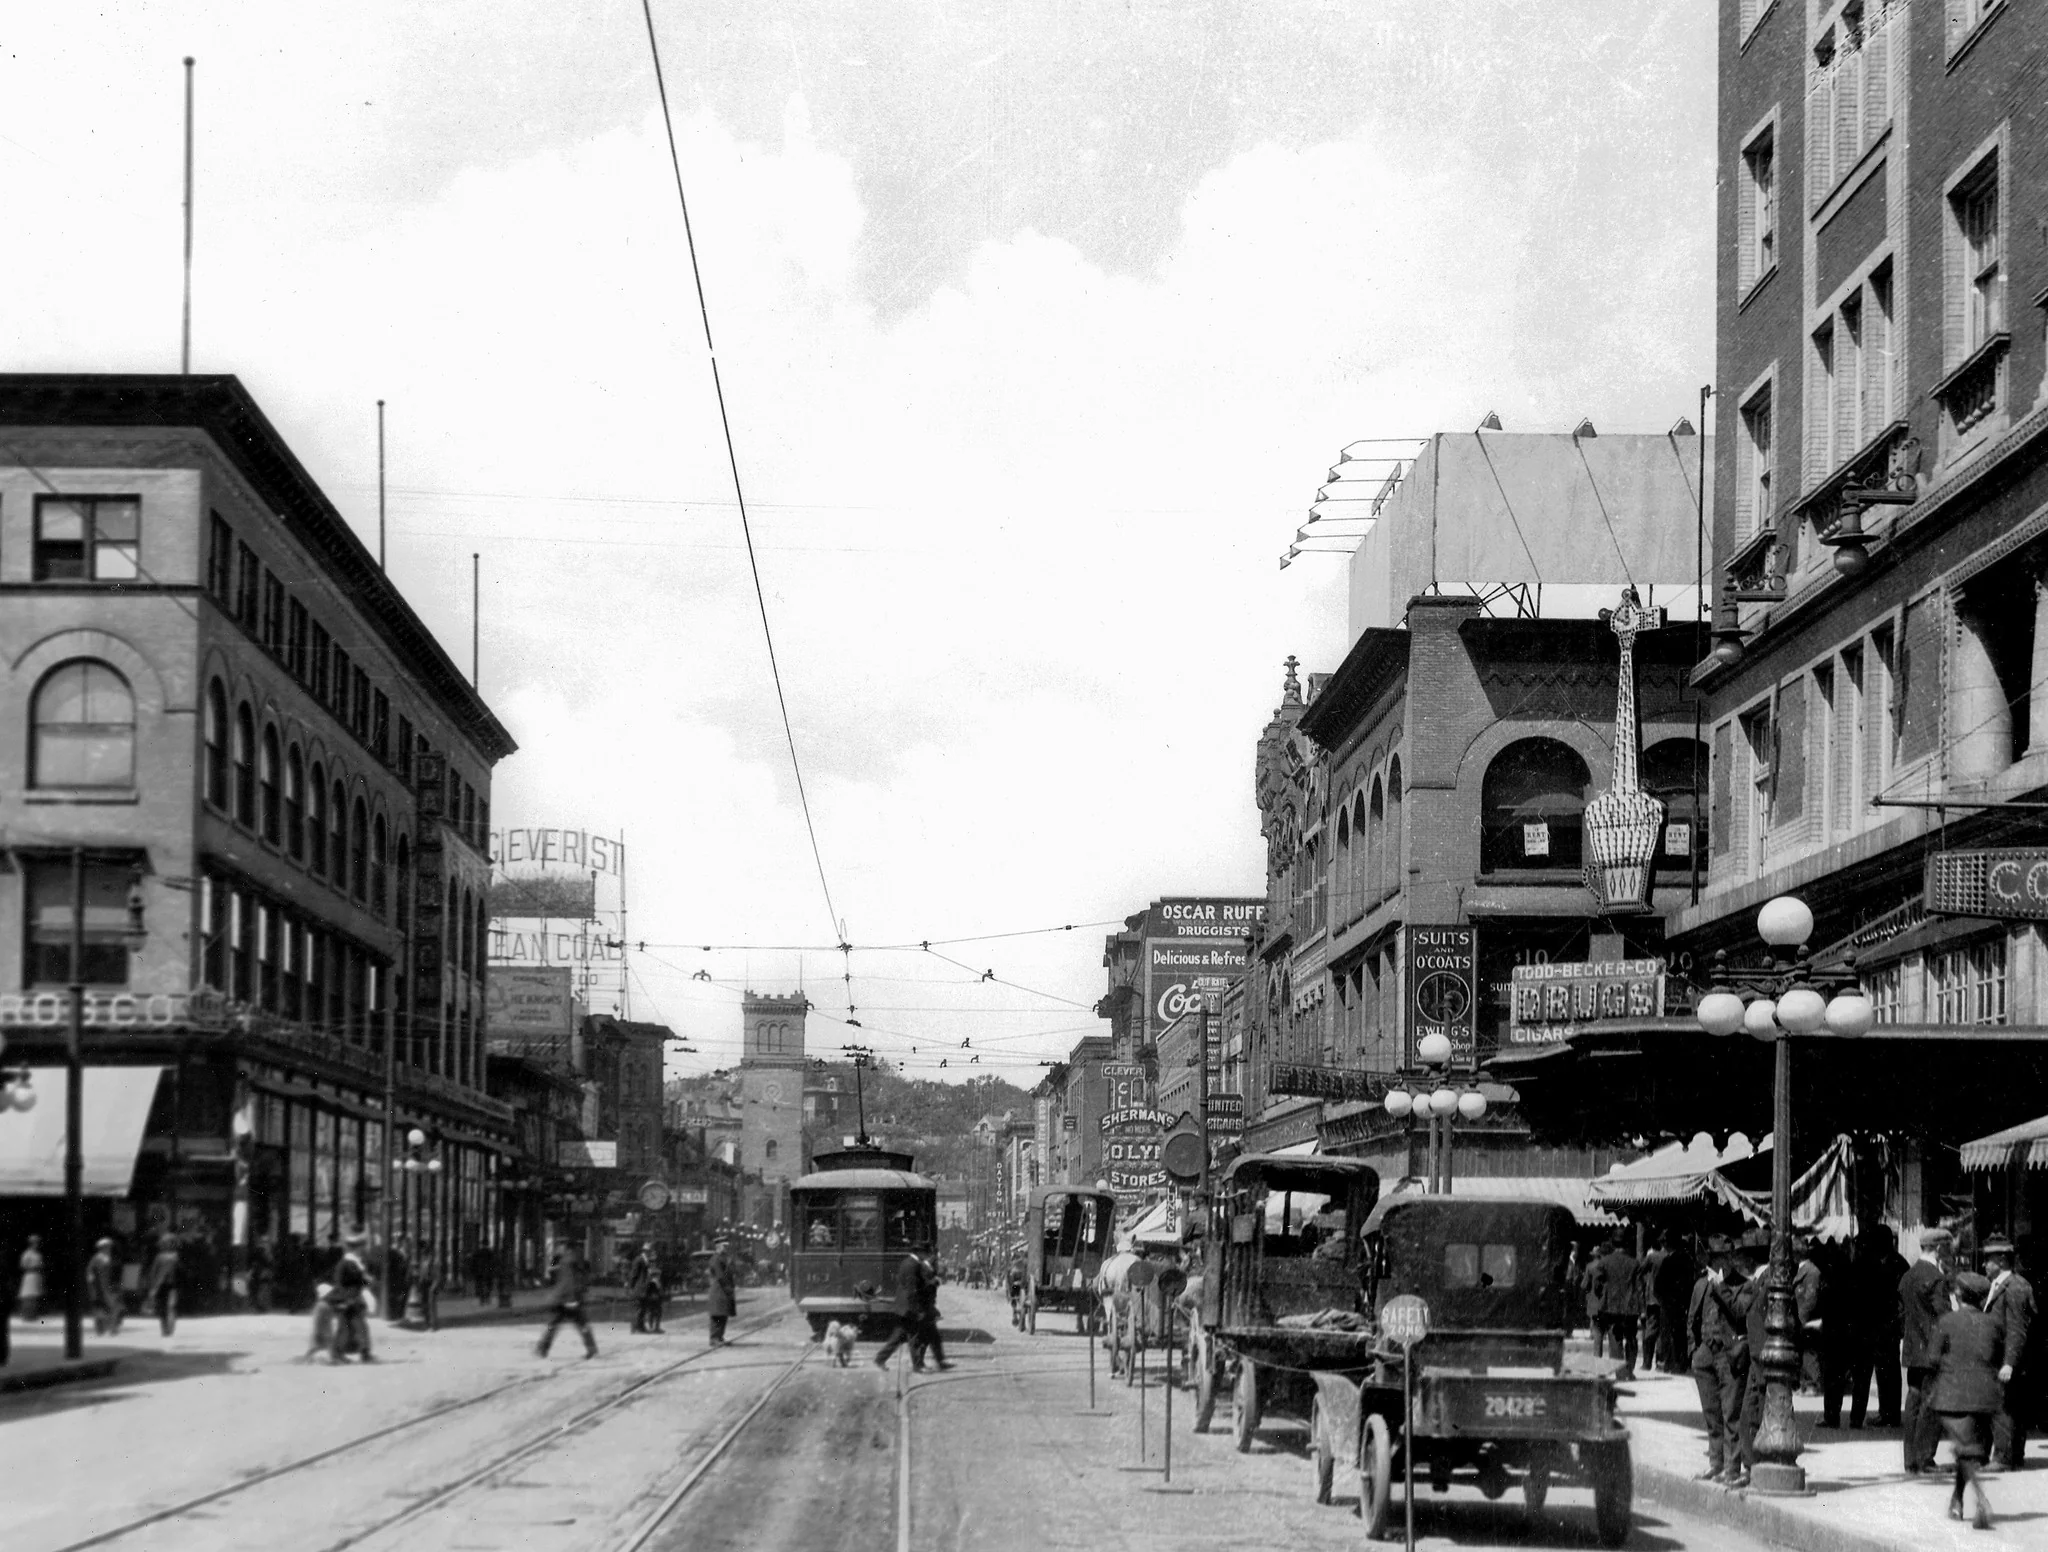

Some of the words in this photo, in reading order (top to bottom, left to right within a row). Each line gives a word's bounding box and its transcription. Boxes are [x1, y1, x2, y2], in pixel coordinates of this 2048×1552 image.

[509, 828, 624, 877] EVERIST
[1163, 905, 1215, 920] OSCAR
[1224, 905, 1265, 920] RUFF
[1178, 926, 1250, 936] DRUGGISTS
[1418, 932, 1470, 945] SUITS
[557, 933, 623, 961] COAL
[1153, 950, 1200, 965] Delicious
[1202, 953, 1209, 965] &
[1416, 955, 1471, 969] O'COATS
[1518, 982, 1654, 1022] DRUGS
[1416, 1026, 1470, 1037] EWIG'S
[1451, 1037, 1471, 1053] Shop
[1104, 1066, 1143, 1076] CLEVER
[1208, 1099, 1242, 1112] UNITED
[1102, 1108, 1175, 1130] SHERMAN'S
[1207, 1118, 1243, 1130] CIGARS
[1111, 1170, 1167, 1187] STORES
[1381, 1306, 1429, 1323] SAFETY
[1389, 1324, 1422, 1337] ZONE
